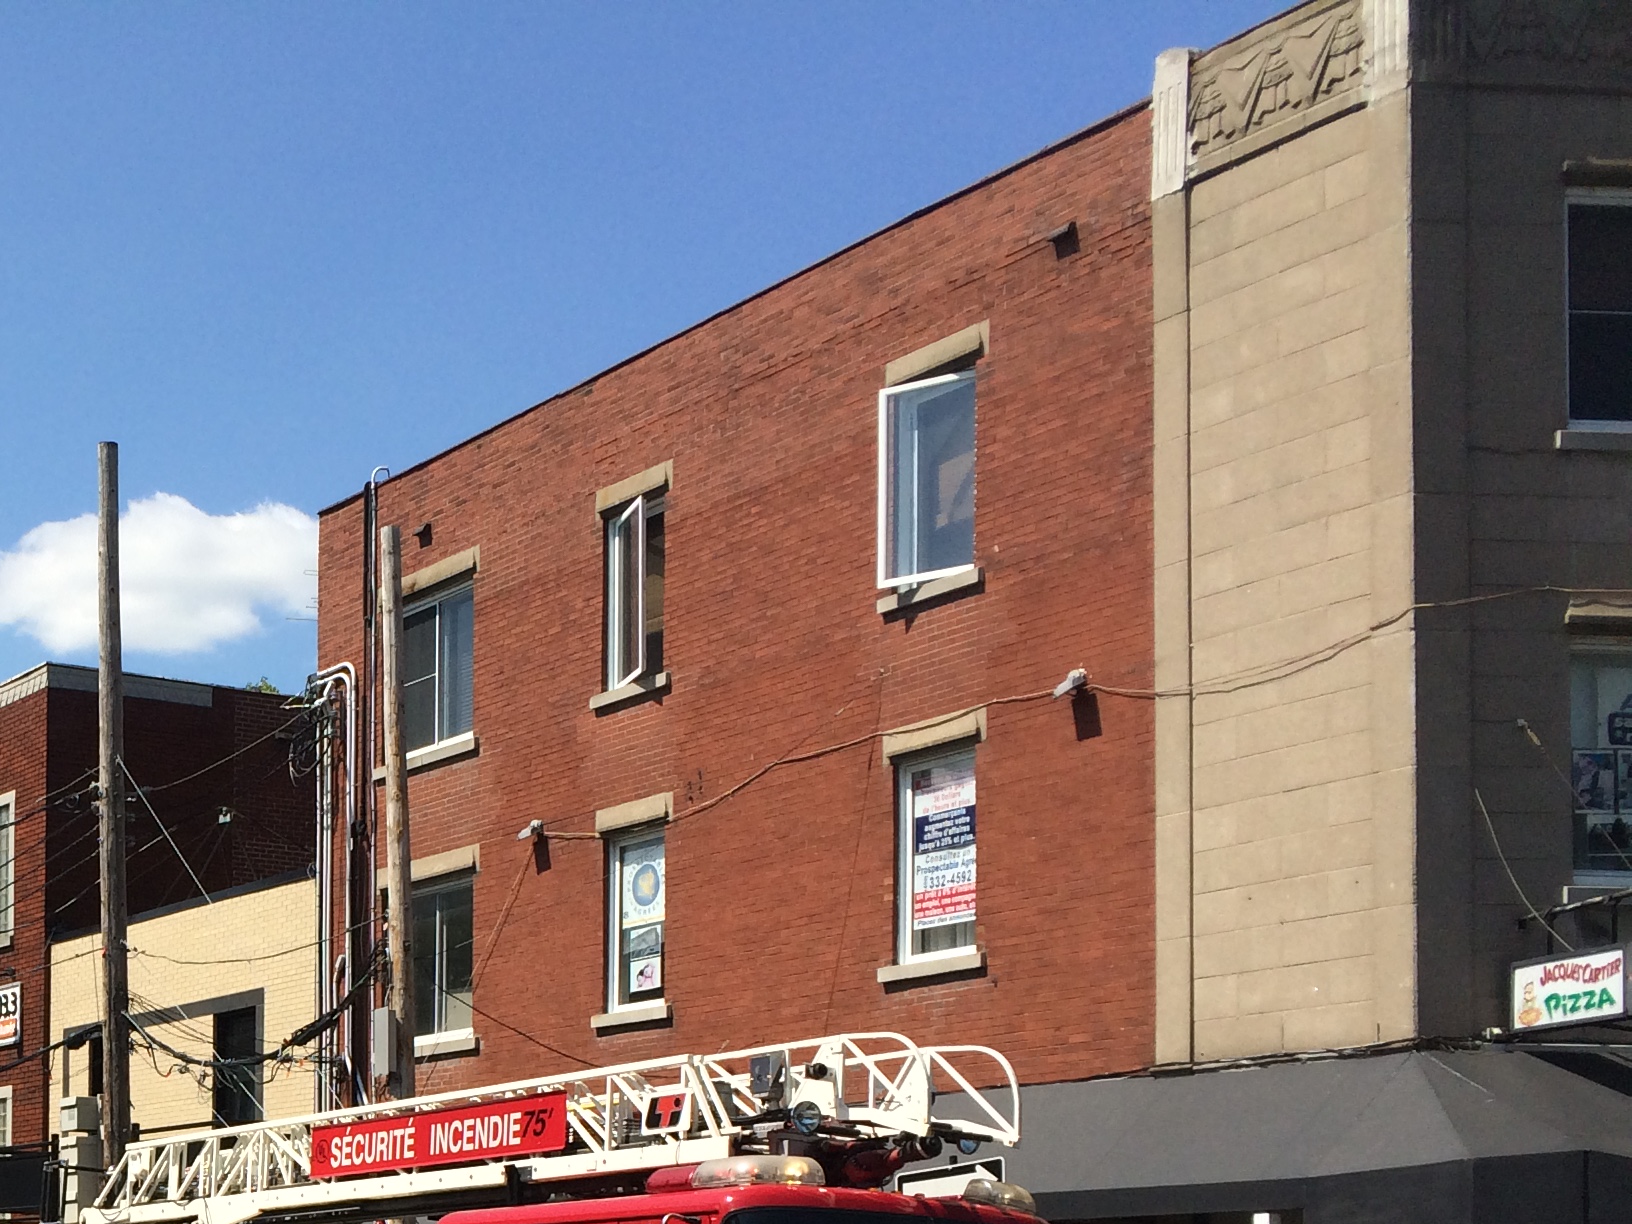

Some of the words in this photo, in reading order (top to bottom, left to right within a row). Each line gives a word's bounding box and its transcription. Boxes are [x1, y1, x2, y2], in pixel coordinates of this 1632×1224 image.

[925, 851, 960, 863] Consultez
[916, 860, 959, 875] Prospectable
[929, 869, 972, 889] 332-4592
[1539, 961, 1582, 987] JACQUES
[1582, 957, 1622, 984] CARTIER
[329, 1117, 416, 1169] SÉCURITÉ
[429, 1112, 522, 1156] INCENDIE
